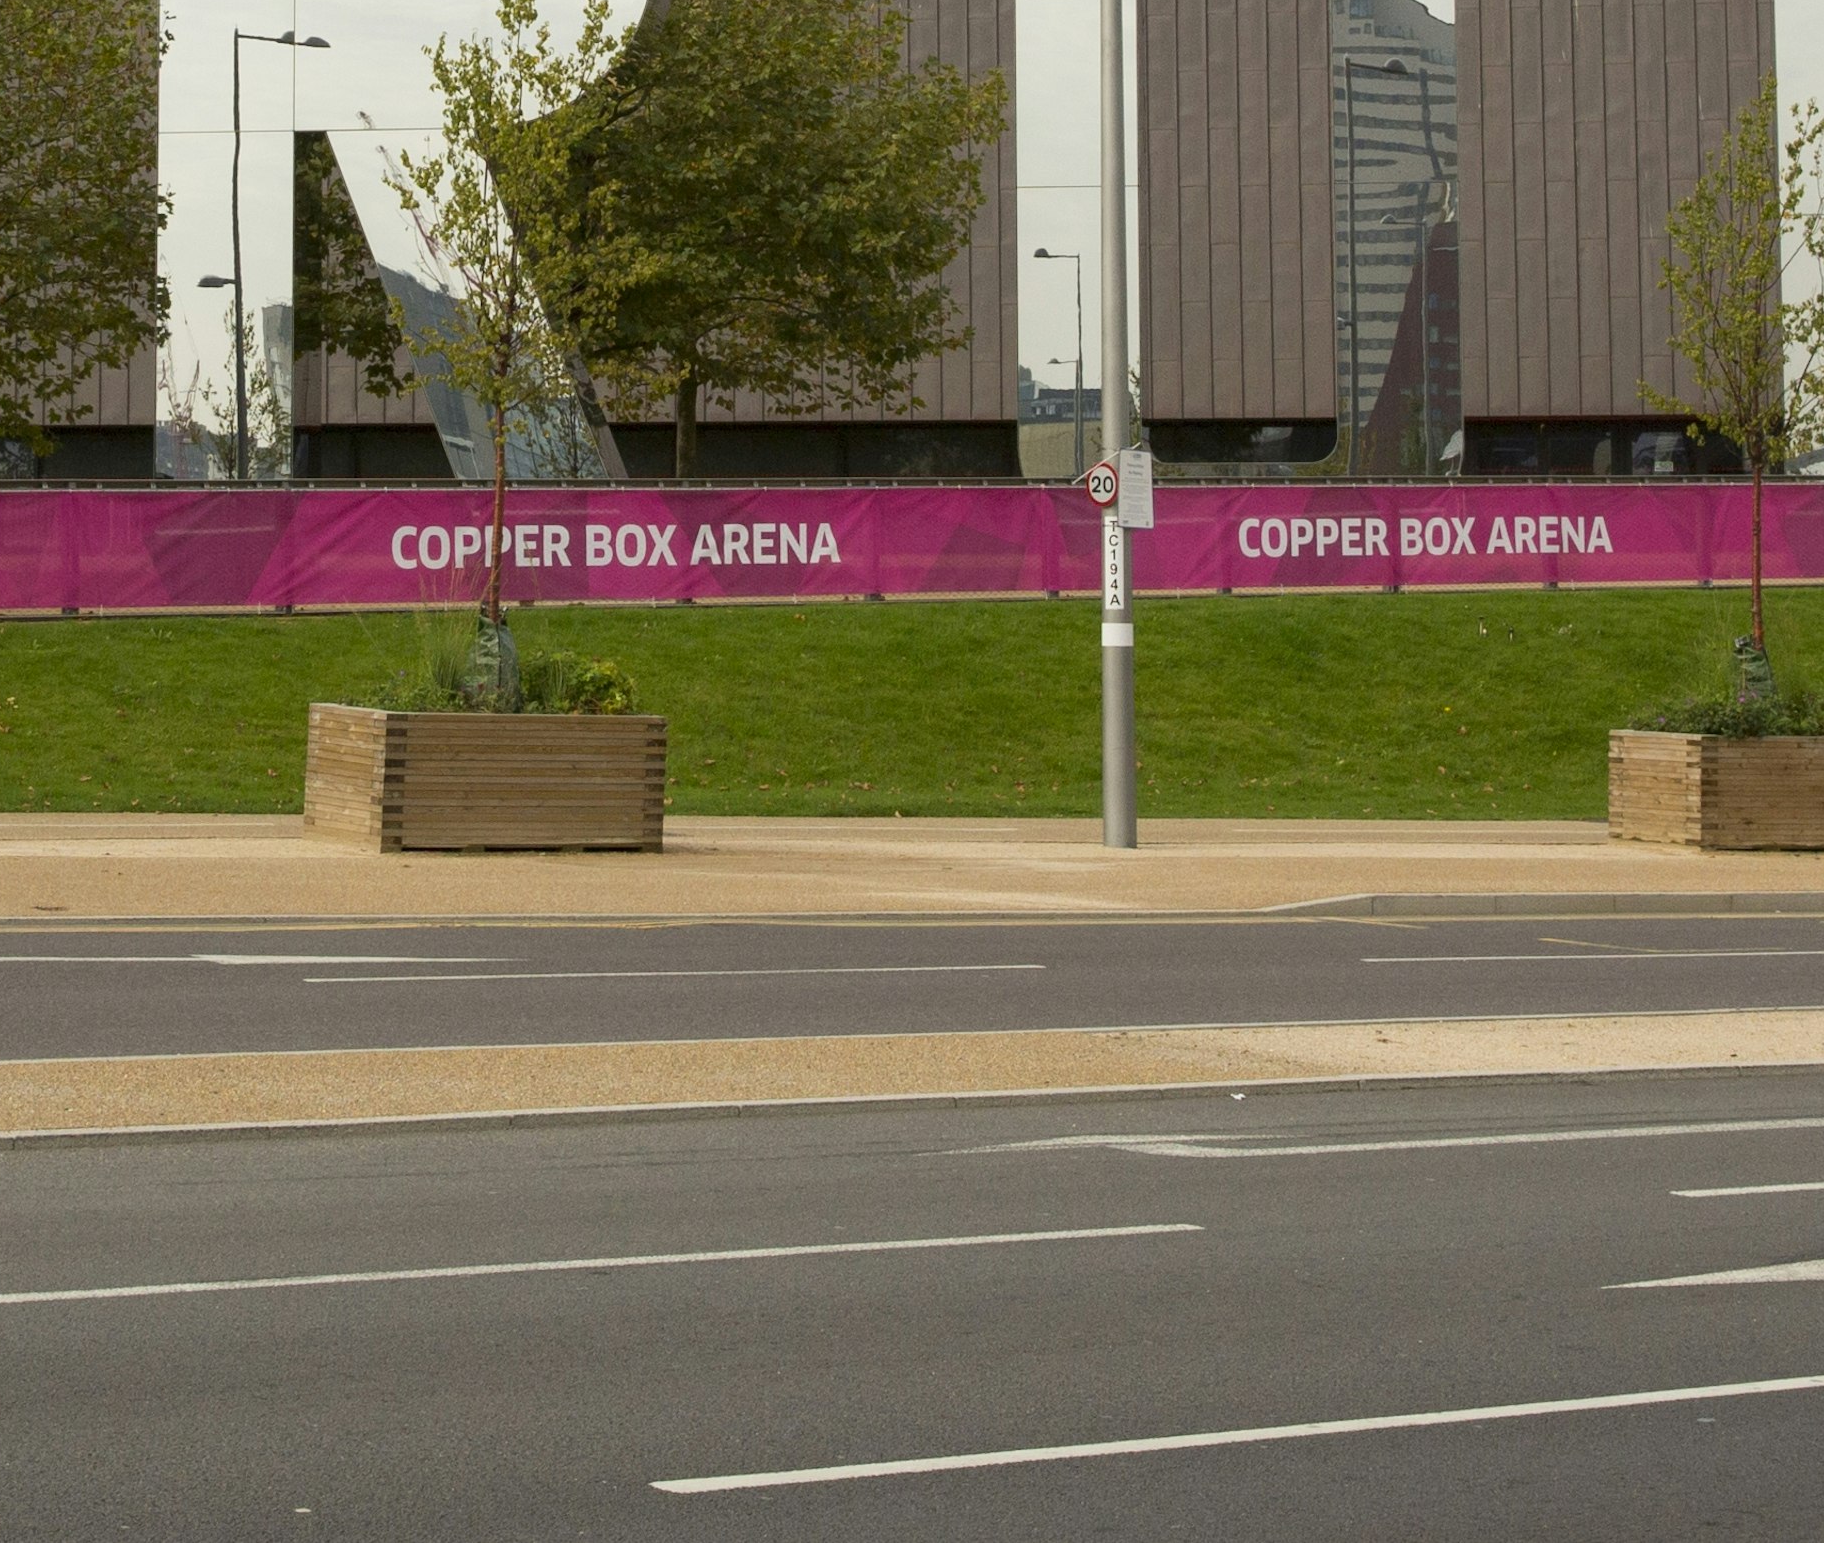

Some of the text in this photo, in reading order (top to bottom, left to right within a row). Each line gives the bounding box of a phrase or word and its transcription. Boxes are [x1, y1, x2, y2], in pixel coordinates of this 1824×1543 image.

[1091, 476, 1114, 493] 20
[391, 523, 841, 569] COPPER BOX ARENA
[1238, 516, 1613, 557] COPPER BOX ARENA
